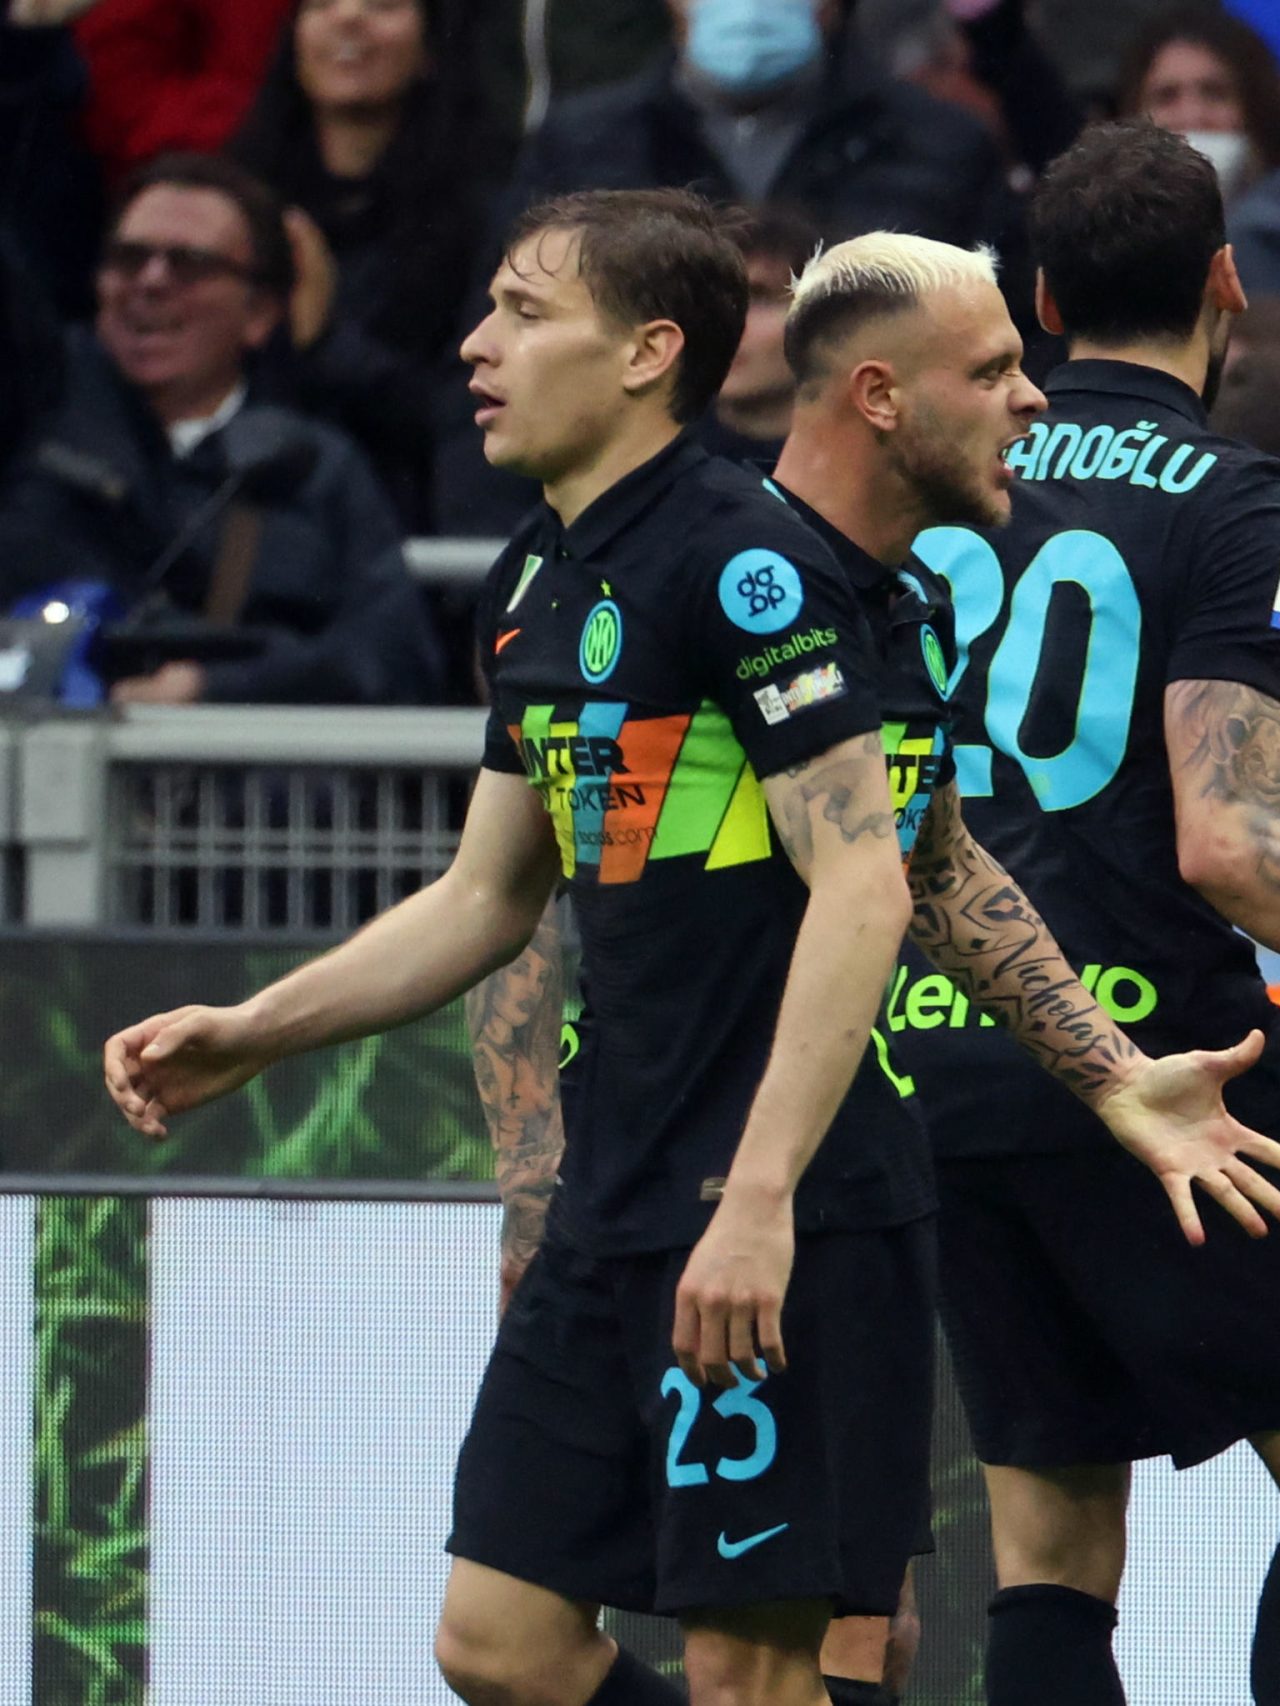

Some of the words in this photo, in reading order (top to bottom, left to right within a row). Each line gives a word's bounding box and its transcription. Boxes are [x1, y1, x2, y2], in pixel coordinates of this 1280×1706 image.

[1004, 420, 1218, 494] ANOĞLU
[736, 627, 839, 680] digitalbits
[905, 526, 1142, 812] 20
[555, 784, 647, 812] TOKEN
[886, 964, 1158, 1032] Leno
[661, 1357, 777, 1488] 23
